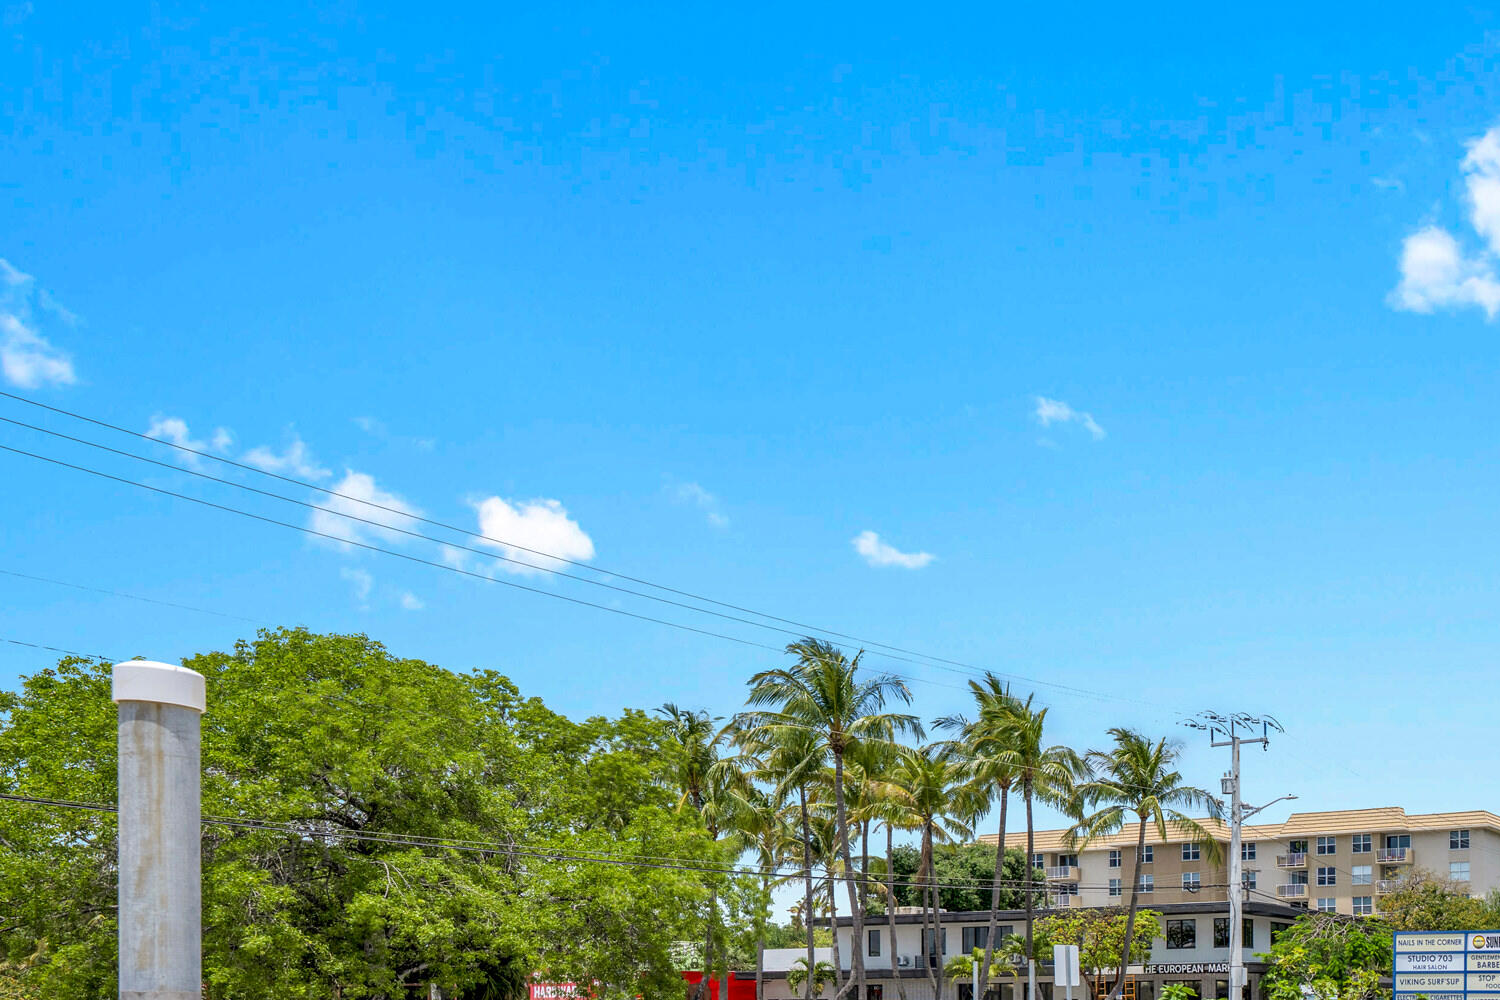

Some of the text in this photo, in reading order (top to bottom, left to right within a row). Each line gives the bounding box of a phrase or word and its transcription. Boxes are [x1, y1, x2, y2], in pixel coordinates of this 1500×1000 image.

[1437, 938, 1462, 946] CORNER
[1438, 954, 1453, 962] 703
[1145, 963, 1231, 974] HE EUROPEAN MAR
[1400, 978, 1426, 986] VIKING
